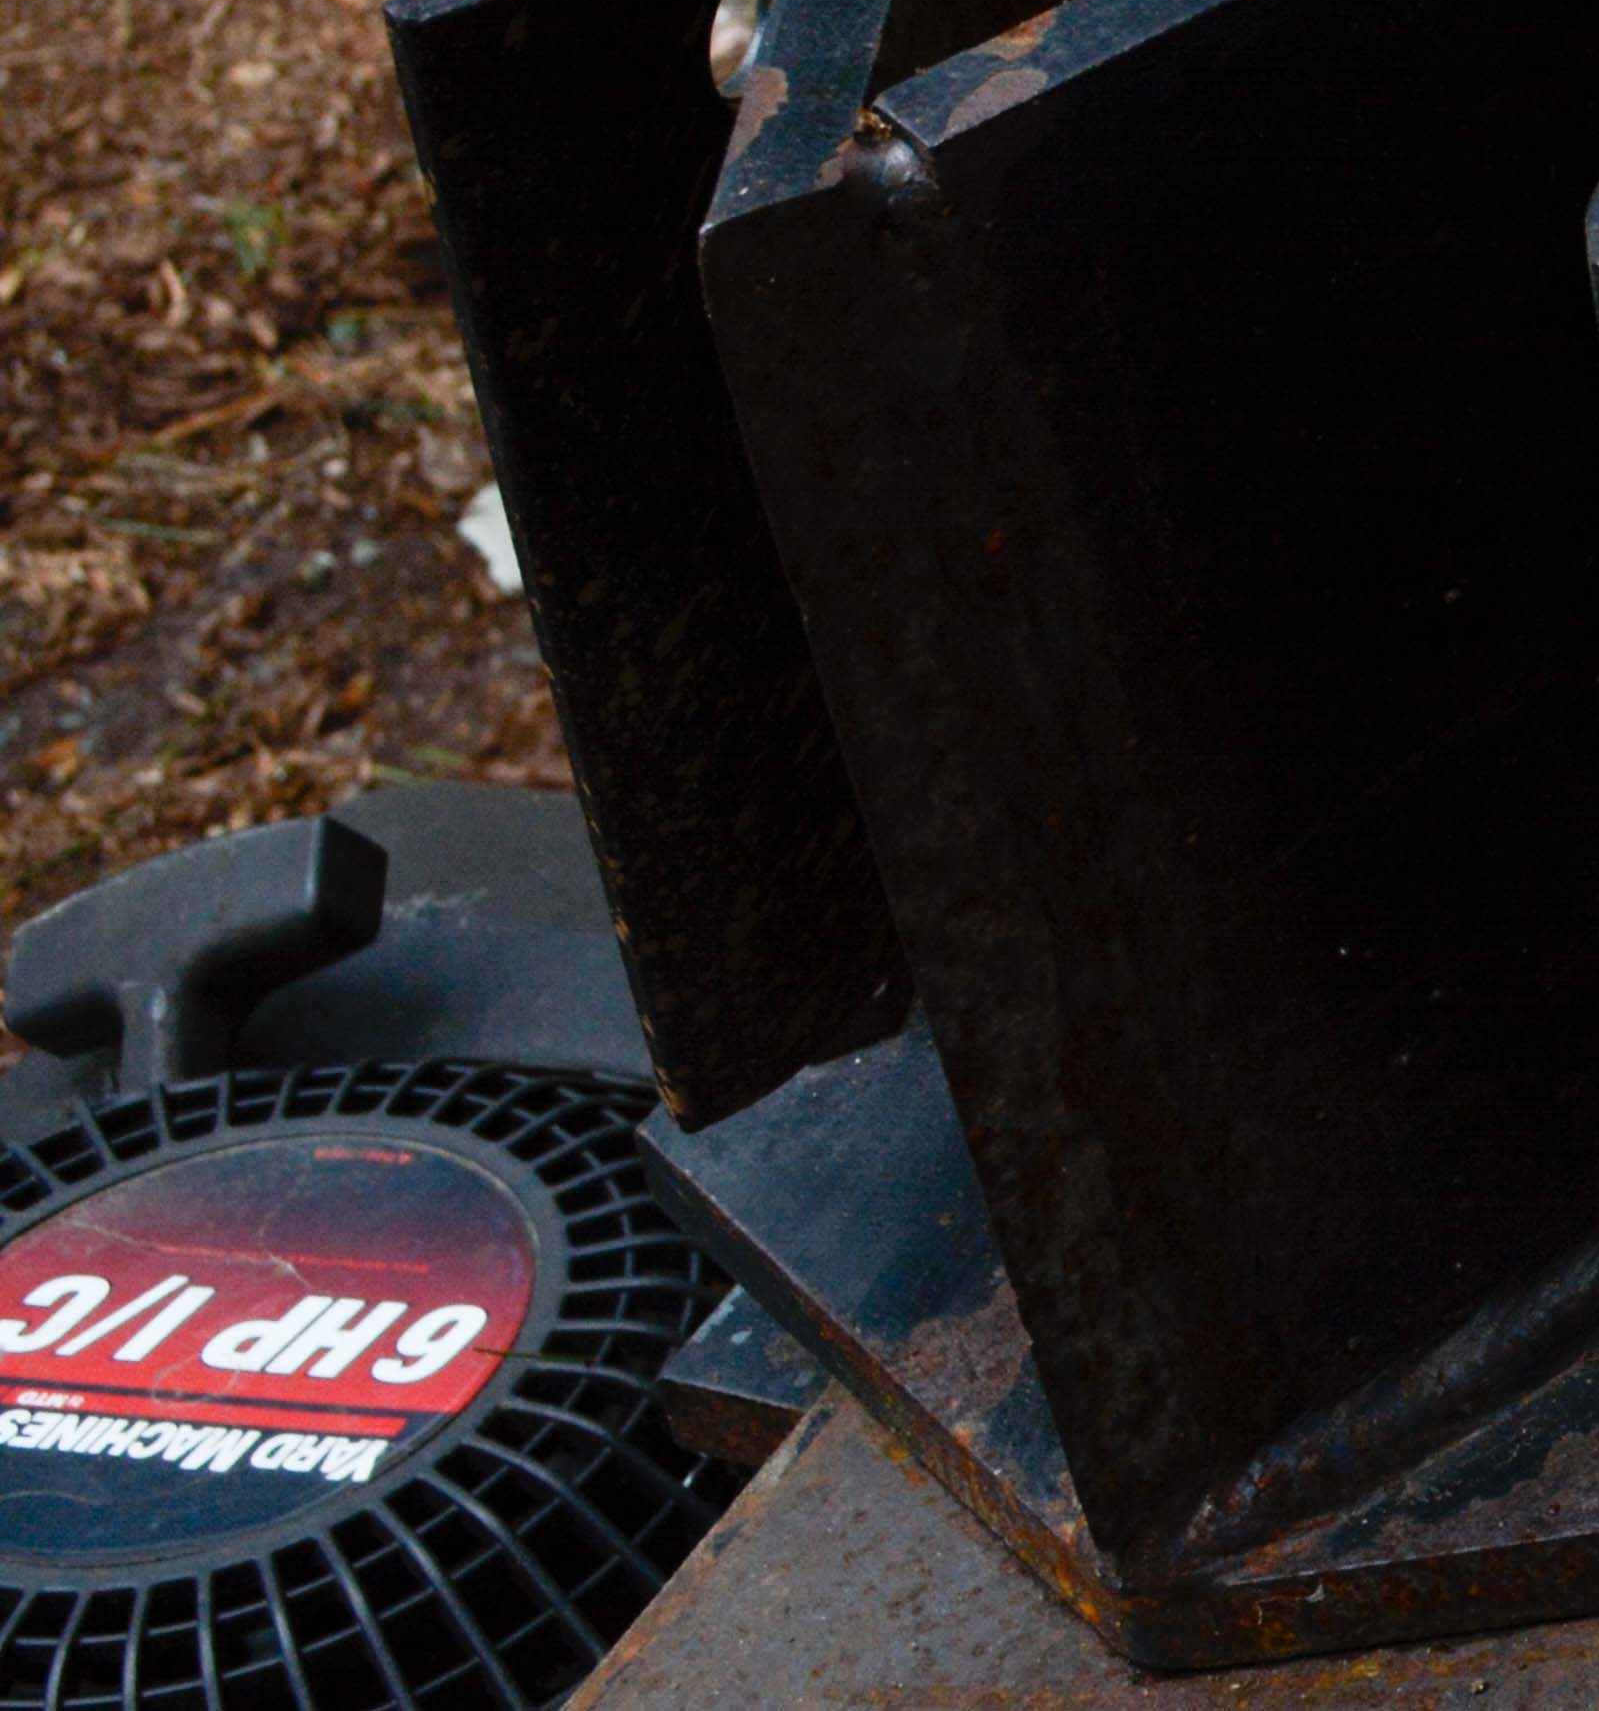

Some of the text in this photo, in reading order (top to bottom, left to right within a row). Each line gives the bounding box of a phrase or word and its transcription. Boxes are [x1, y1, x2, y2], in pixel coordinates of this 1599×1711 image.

[201, 1295, 408, 1379] HP
[371, 1304, 488, 1384] 6
[0, 1408, 389, 1482] YARD MACHINES
